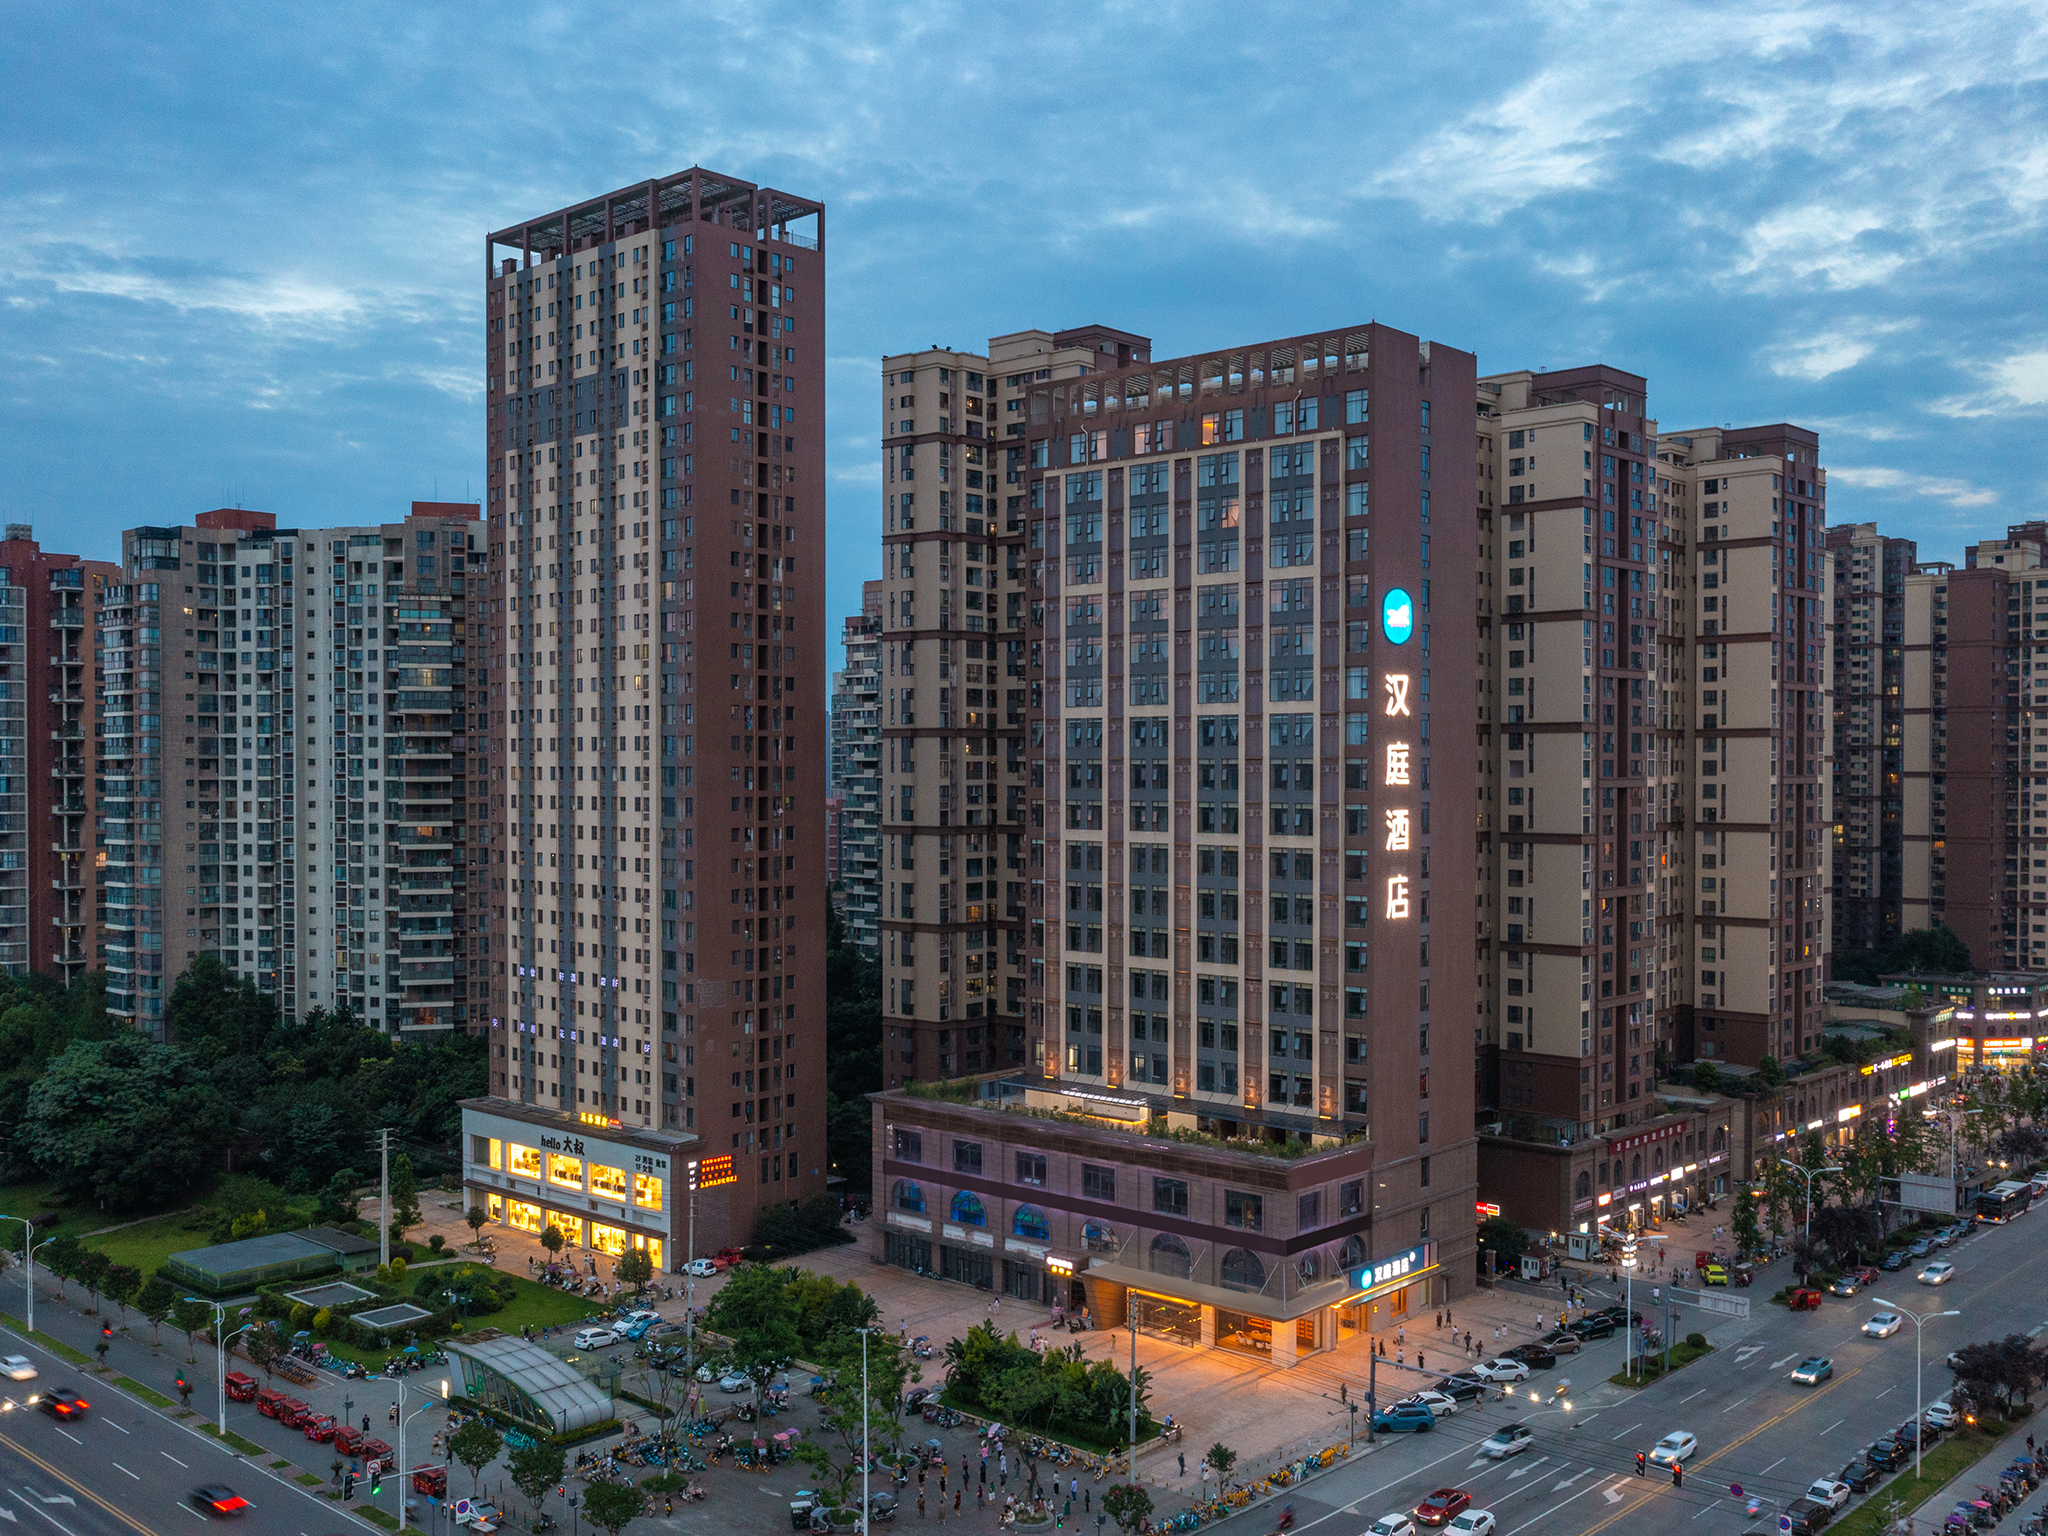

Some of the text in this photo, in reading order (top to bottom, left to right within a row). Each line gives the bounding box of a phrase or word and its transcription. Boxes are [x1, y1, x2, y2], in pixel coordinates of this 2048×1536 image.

[1385, 673, 1411, 920] 汉庭酒店
[541, 1134, 586, 1157] hello 大叔
